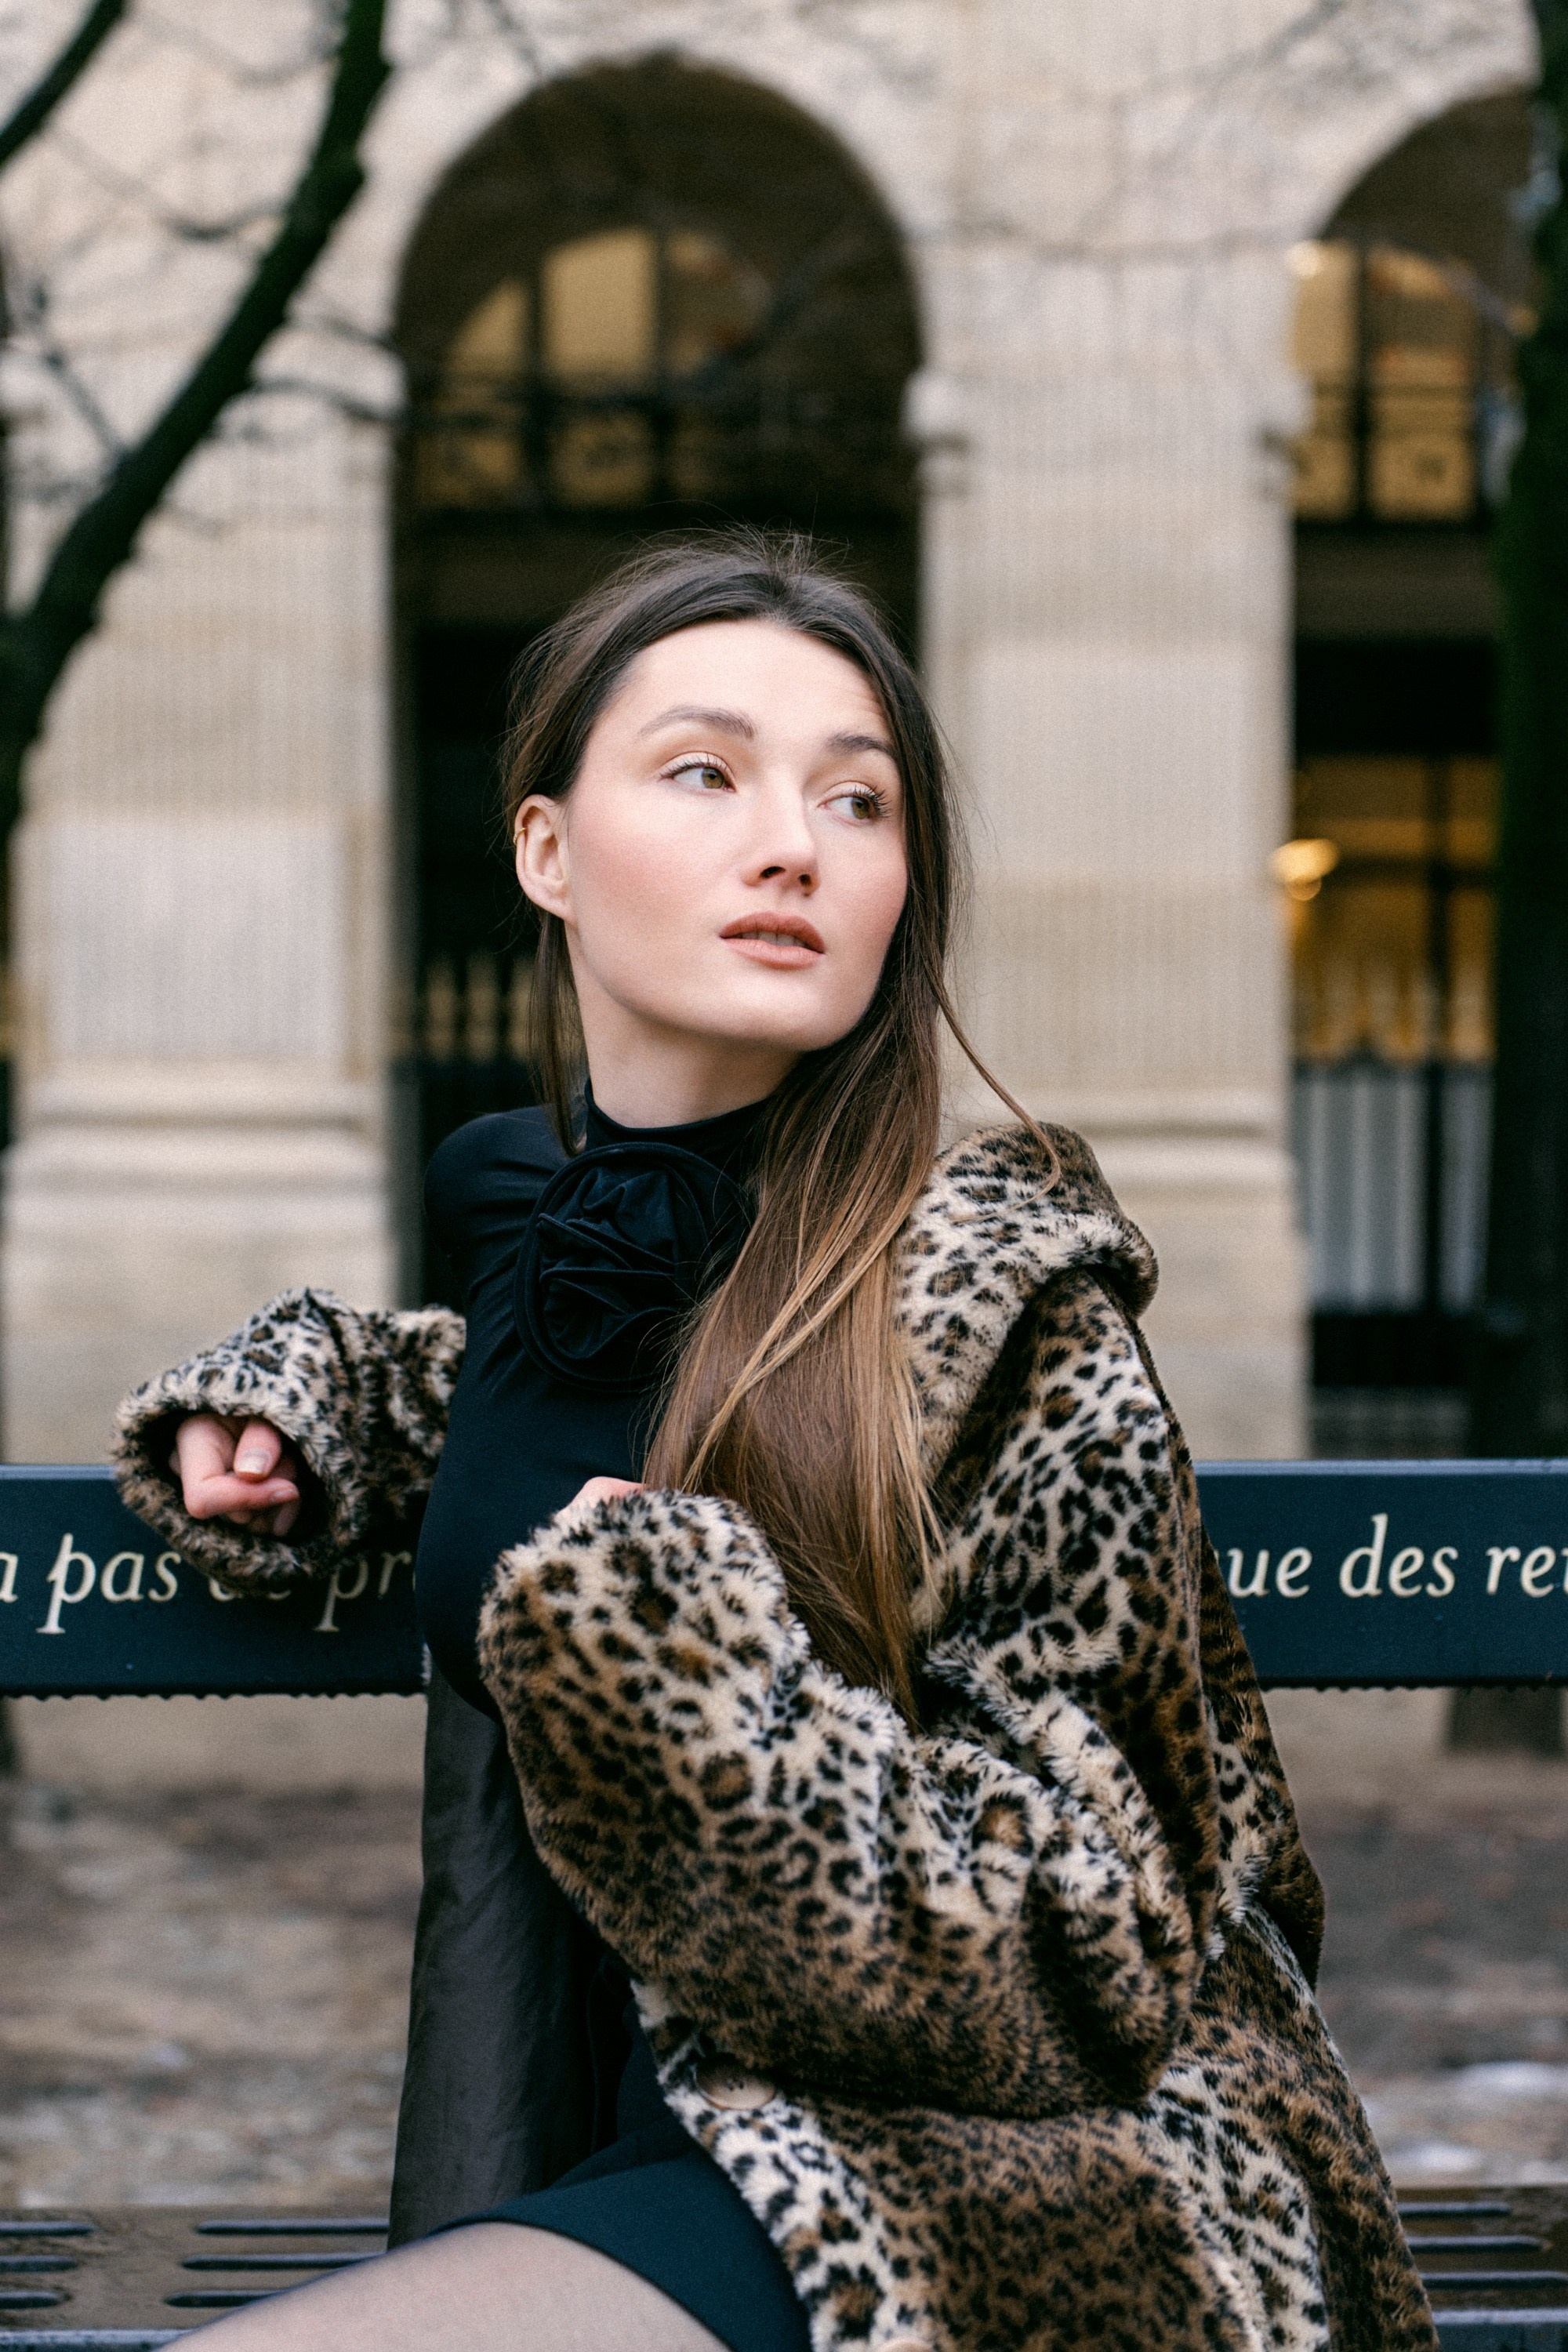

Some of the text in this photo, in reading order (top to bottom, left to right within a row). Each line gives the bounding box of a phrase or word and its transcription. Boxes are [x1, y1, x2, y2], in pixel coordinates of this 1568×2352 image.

[36, 1533, 181, 1635] pas
[314, 1551, 416, 1632] pr
[1214, 1547, 1313, 1598] ue
[1339, 1512, 1459, 1598] des
